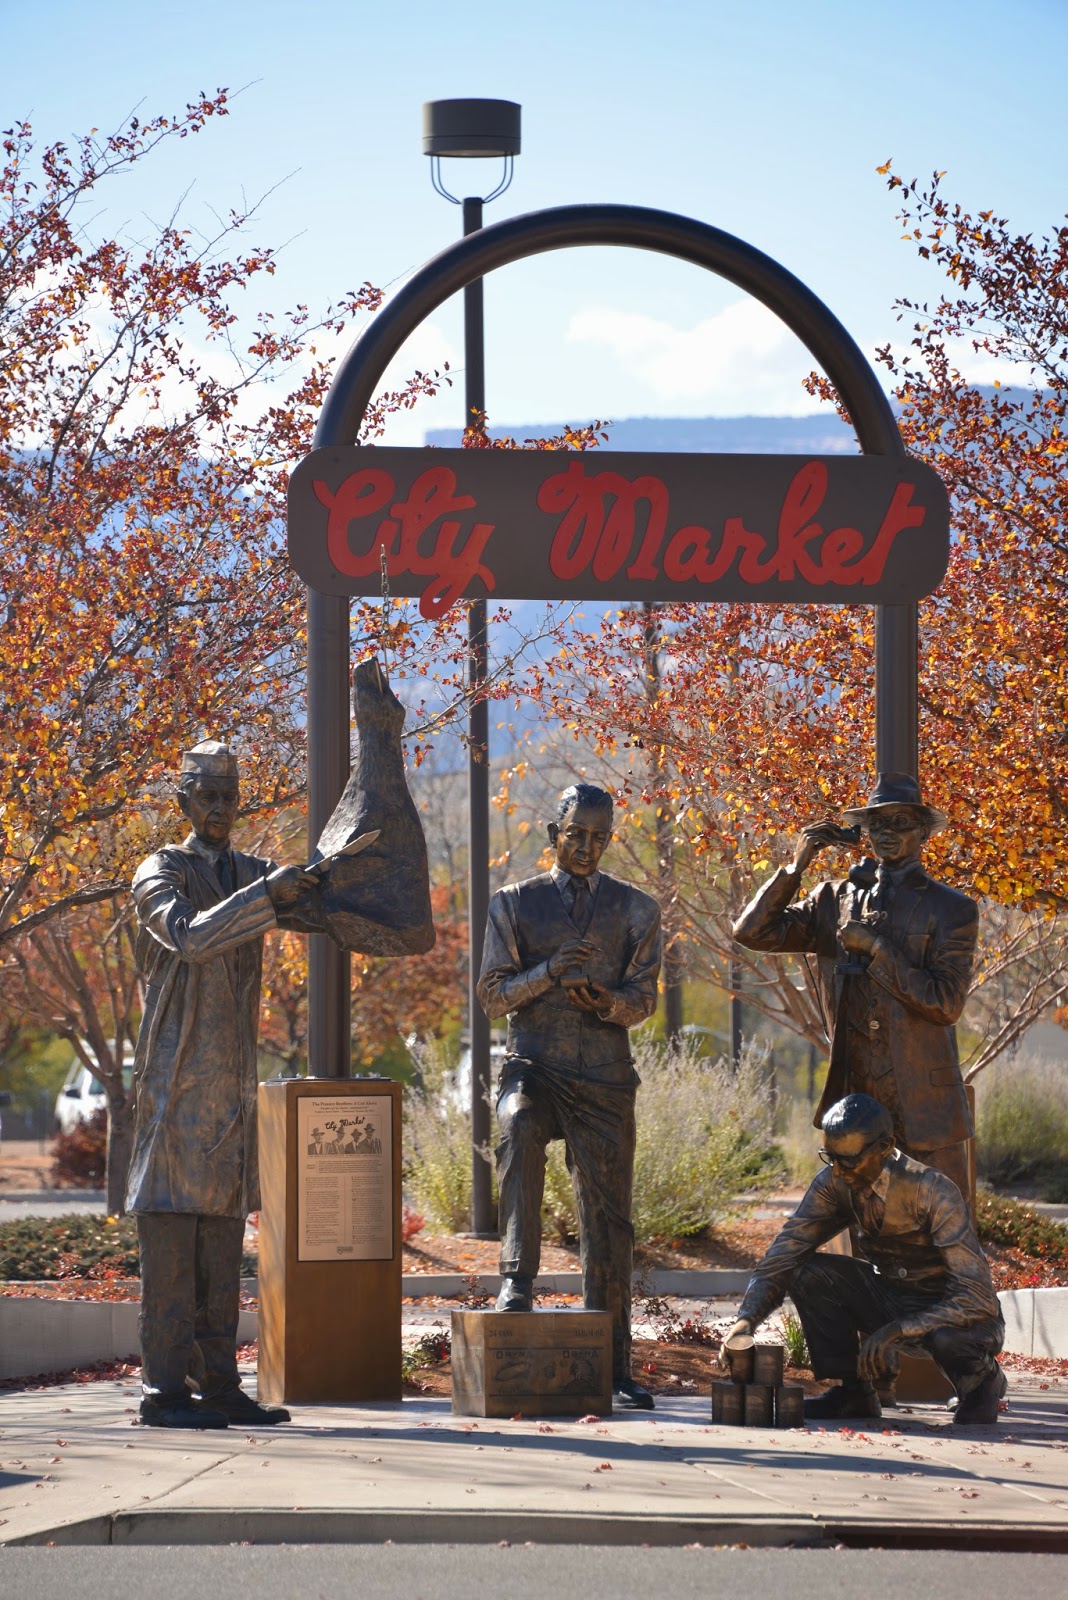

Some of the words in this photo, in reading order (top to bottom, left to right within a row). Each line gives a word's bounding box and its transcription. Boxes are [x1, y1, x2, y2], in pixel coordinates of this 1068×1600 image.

[313, 466, 496, 620] City
[537, 460, 927, 586] Market
[325, 1121, 338, 1131] City
[339, 1116, 366, 1127] Market
